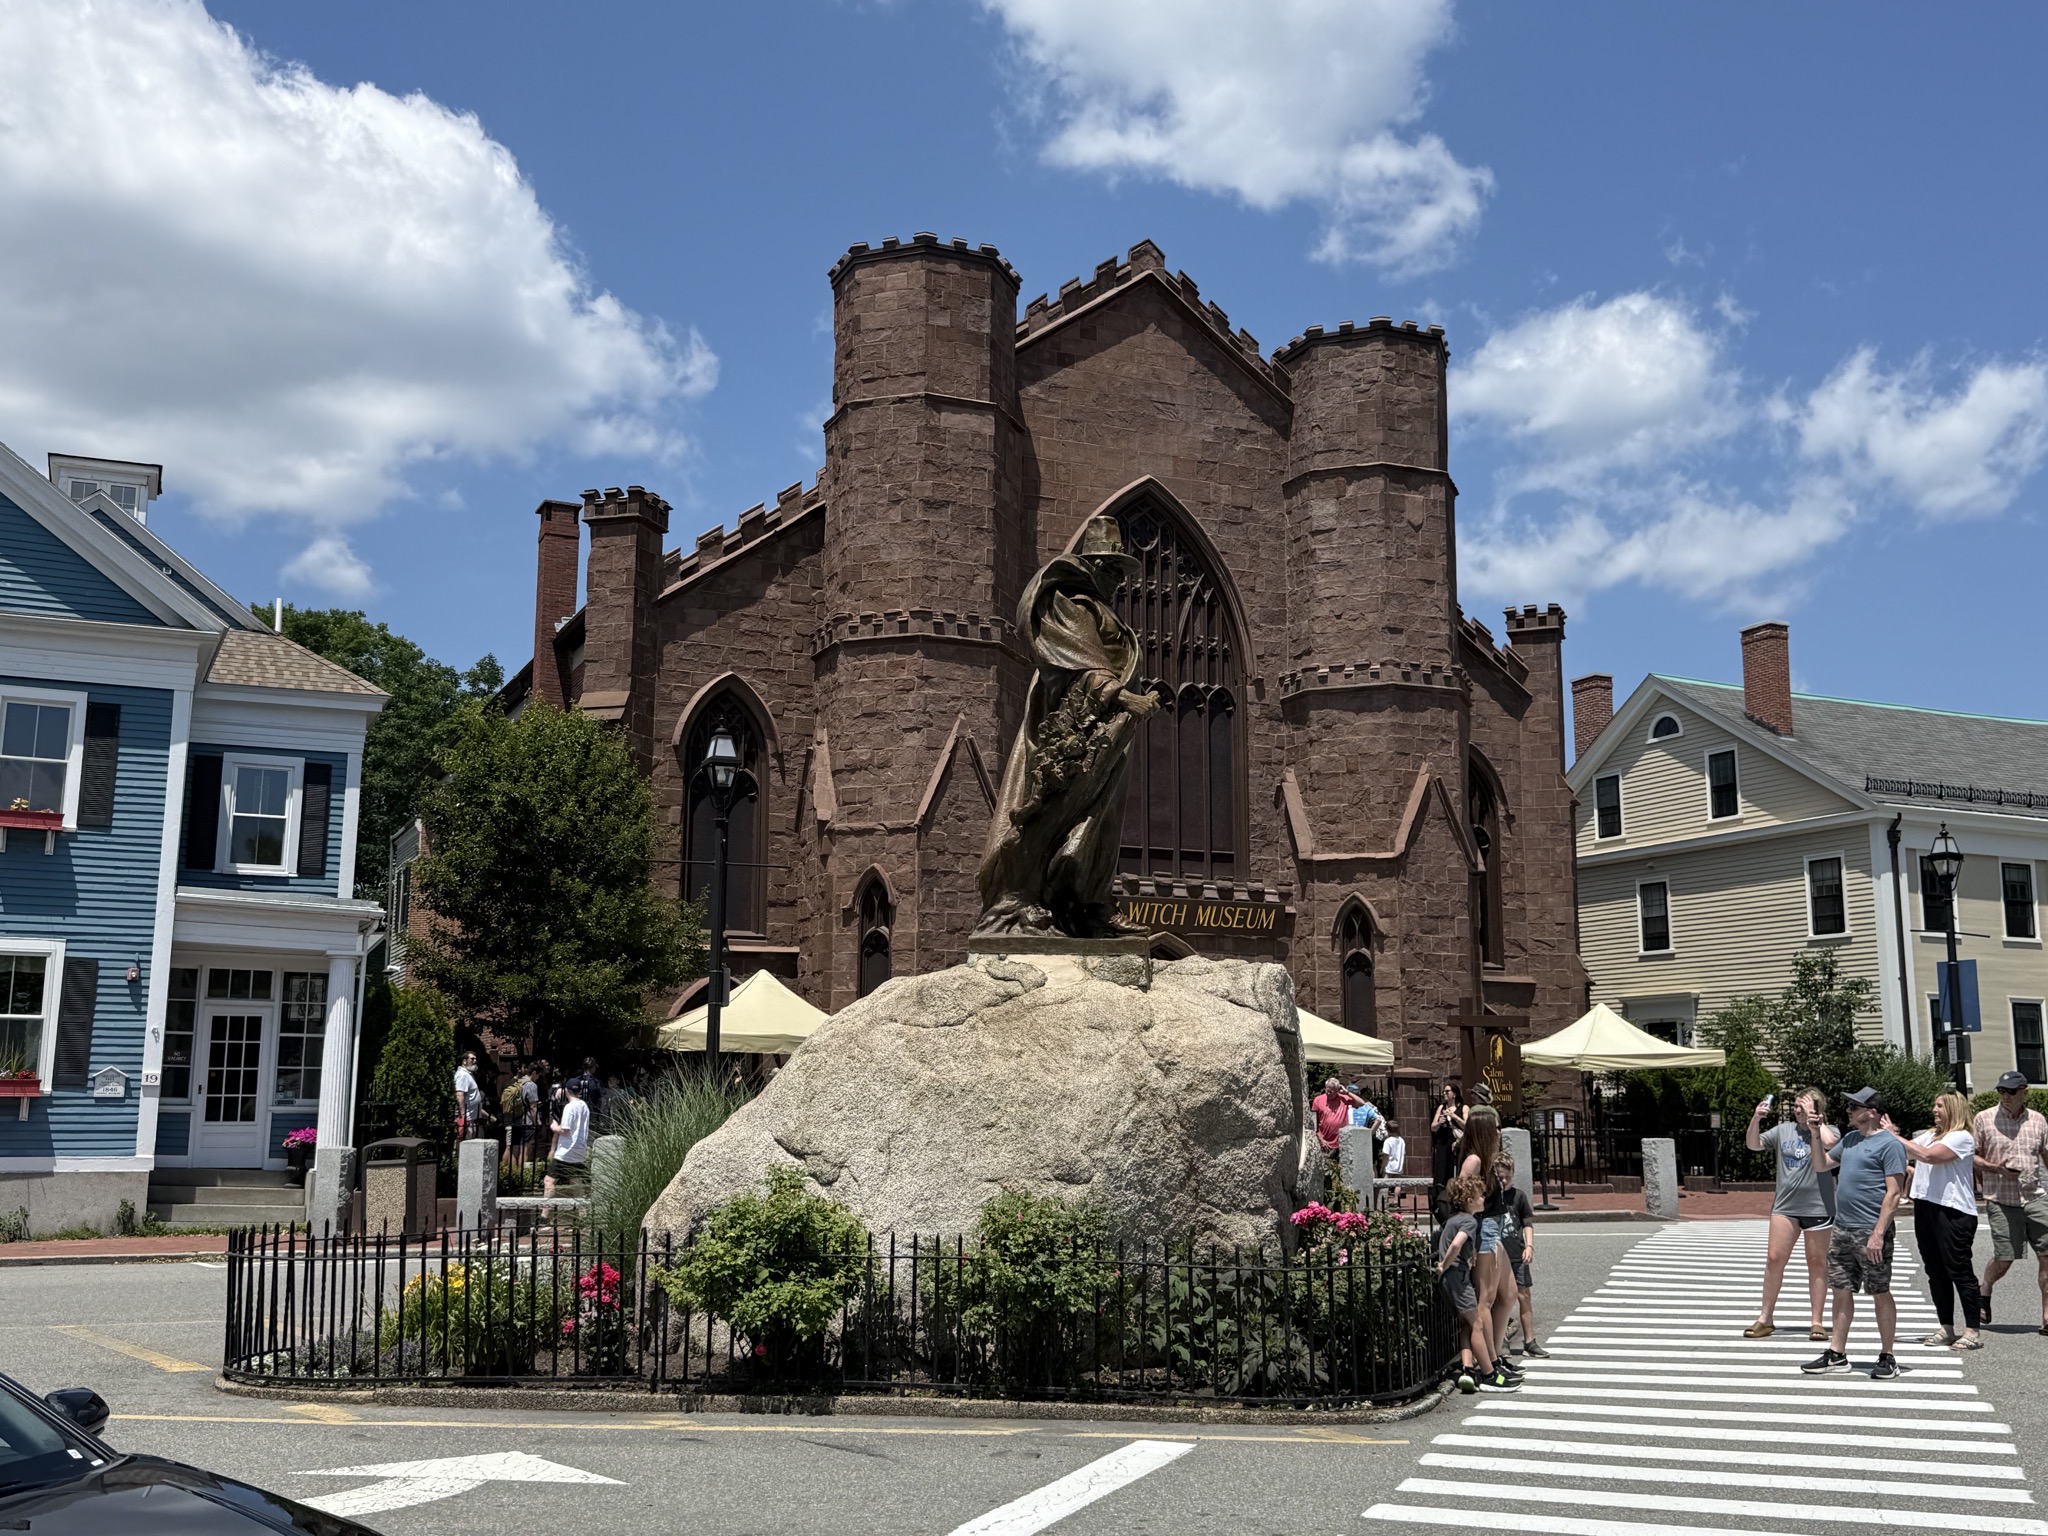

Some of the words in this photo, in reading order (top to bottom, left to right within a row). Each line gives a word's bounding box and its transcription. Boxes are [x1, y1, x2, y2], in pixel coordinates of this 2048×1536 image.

[1128, 901, 1188, 926] WITCH
[1193, 905, 1276, 930] MUSEUM
[145, 1074, 158, 1084] 19
[1482, 1065, 1504, 1086] Salem
[1491, 1078, 1513, 1093] Witch
